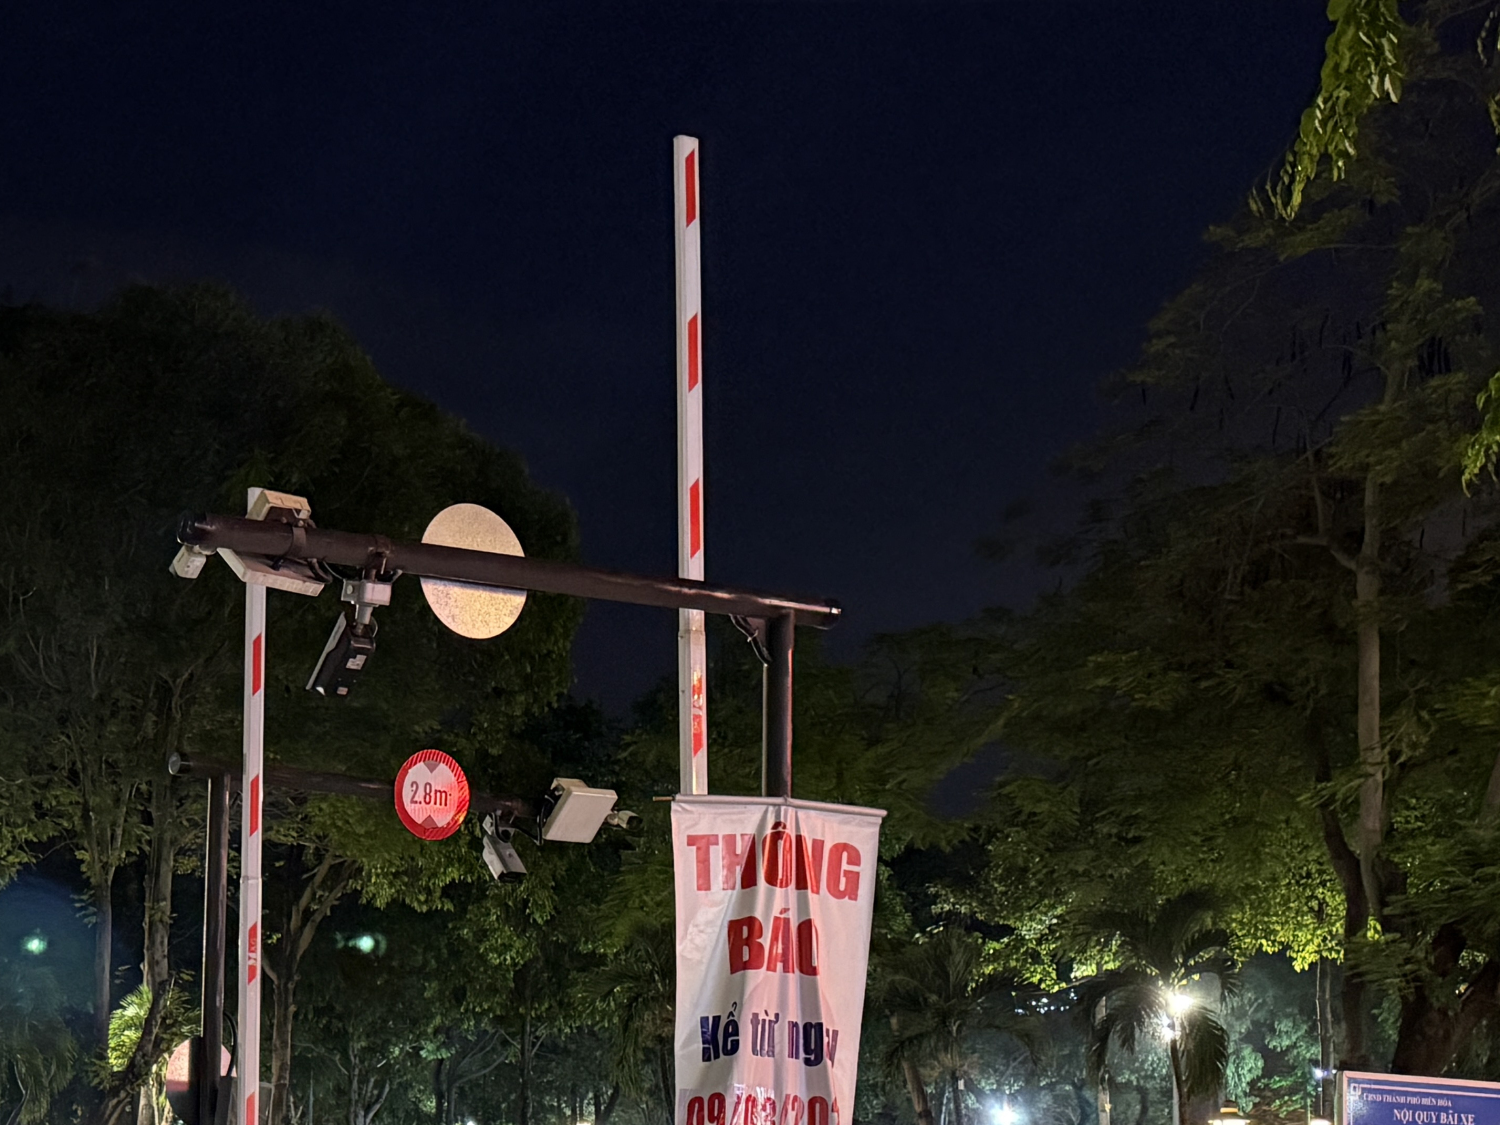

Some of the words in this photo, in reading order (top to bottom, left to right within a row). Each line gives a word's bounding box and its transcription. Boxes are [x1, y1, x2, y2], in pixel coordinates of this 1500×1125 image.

[410, 780, 448, 807] 2.8m
[686, 821, 861, 902] THÔNG
[727, 907, 820, 976] BÁO
[700, 1001, 740, 1063] Kể
[751, 1009, 780, 1059] từ
[787, 1020, 839, 1069] ngy
[1393, 1107, 1413, 1125] NỘI
[1415, 1110, 1438, 1125] QUY
[1440, 1110, 1459, 1125] BÃI
